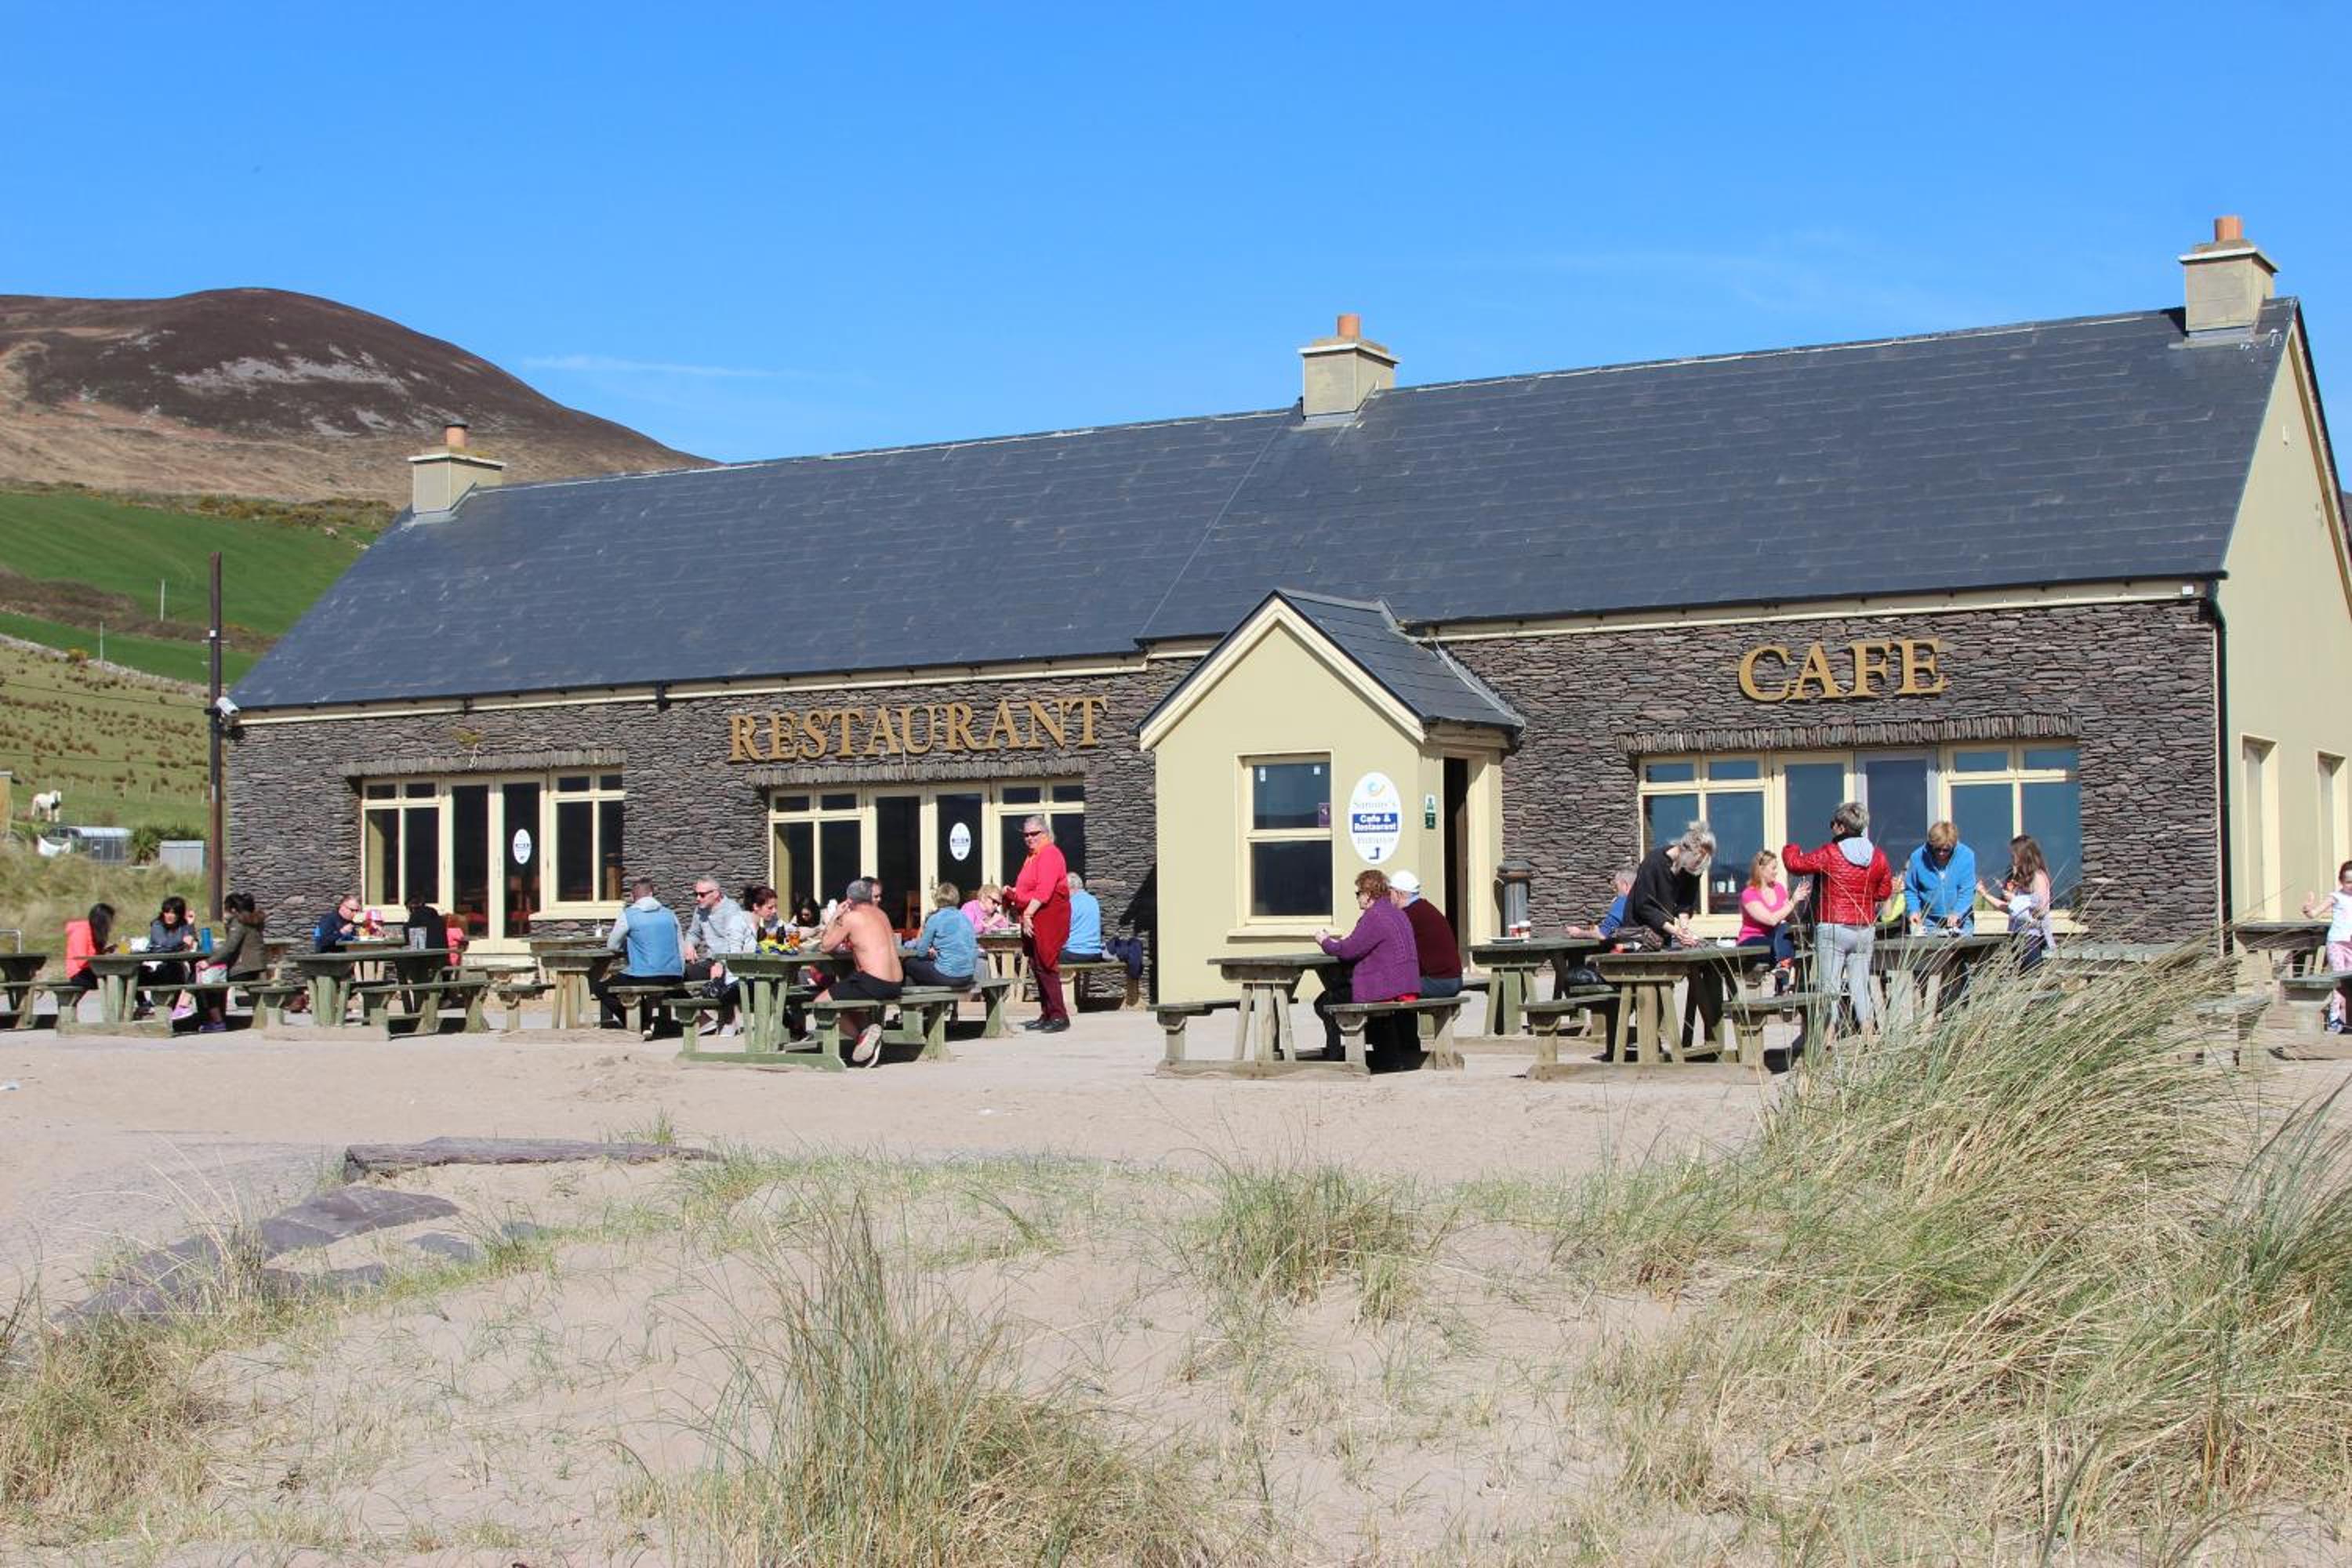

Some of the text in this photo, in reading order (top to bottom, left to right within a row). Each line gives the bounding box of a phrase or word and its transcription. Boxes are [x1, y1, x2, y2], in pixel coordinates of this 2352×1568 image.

[1738, 637, 1947, 702] CAFE
[727, 695, 1108, 763] RESTAURANT
[1384, 814, 1391, 822] &
